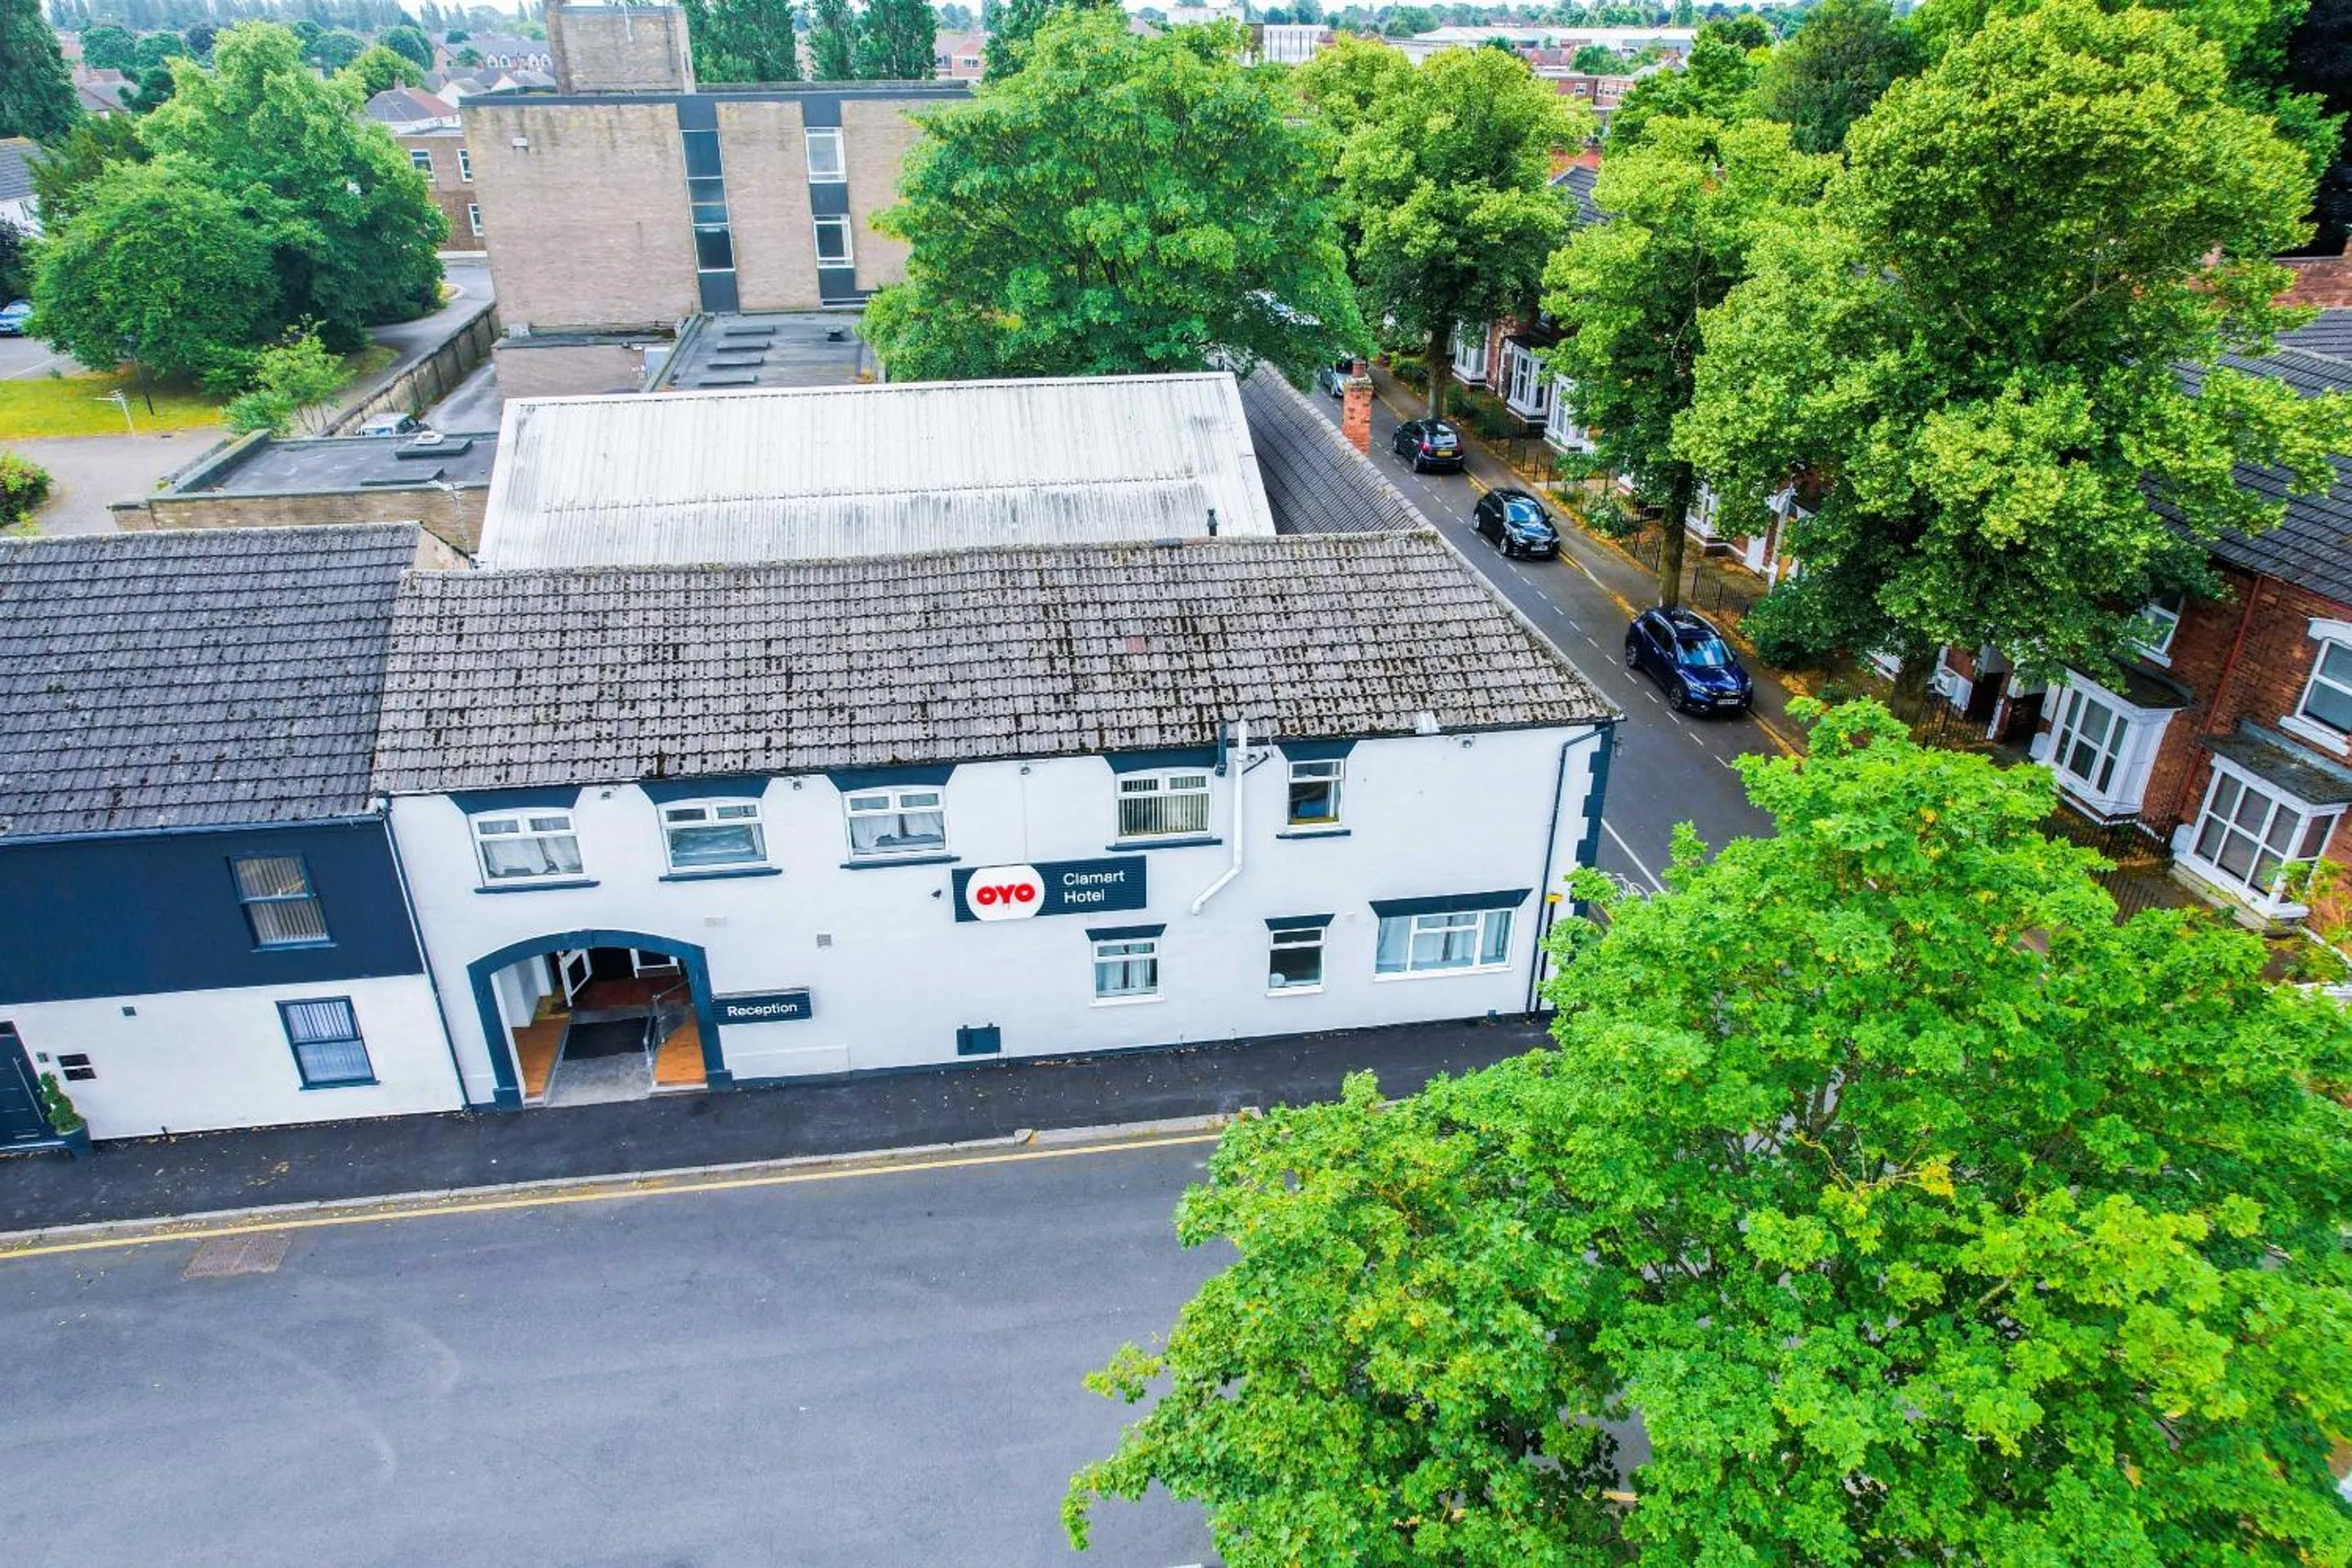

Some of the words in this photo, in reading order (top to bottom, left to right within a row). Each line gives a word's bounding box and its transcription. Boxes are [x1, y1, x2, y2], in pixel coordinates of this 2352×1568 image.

[1063, 871, 1125, 885] Clamart
[976, 883, 1036, 906] OYO
[1064, 889, 1105, 903] Hotel
[727, 1003, 798, 1017] Reception
